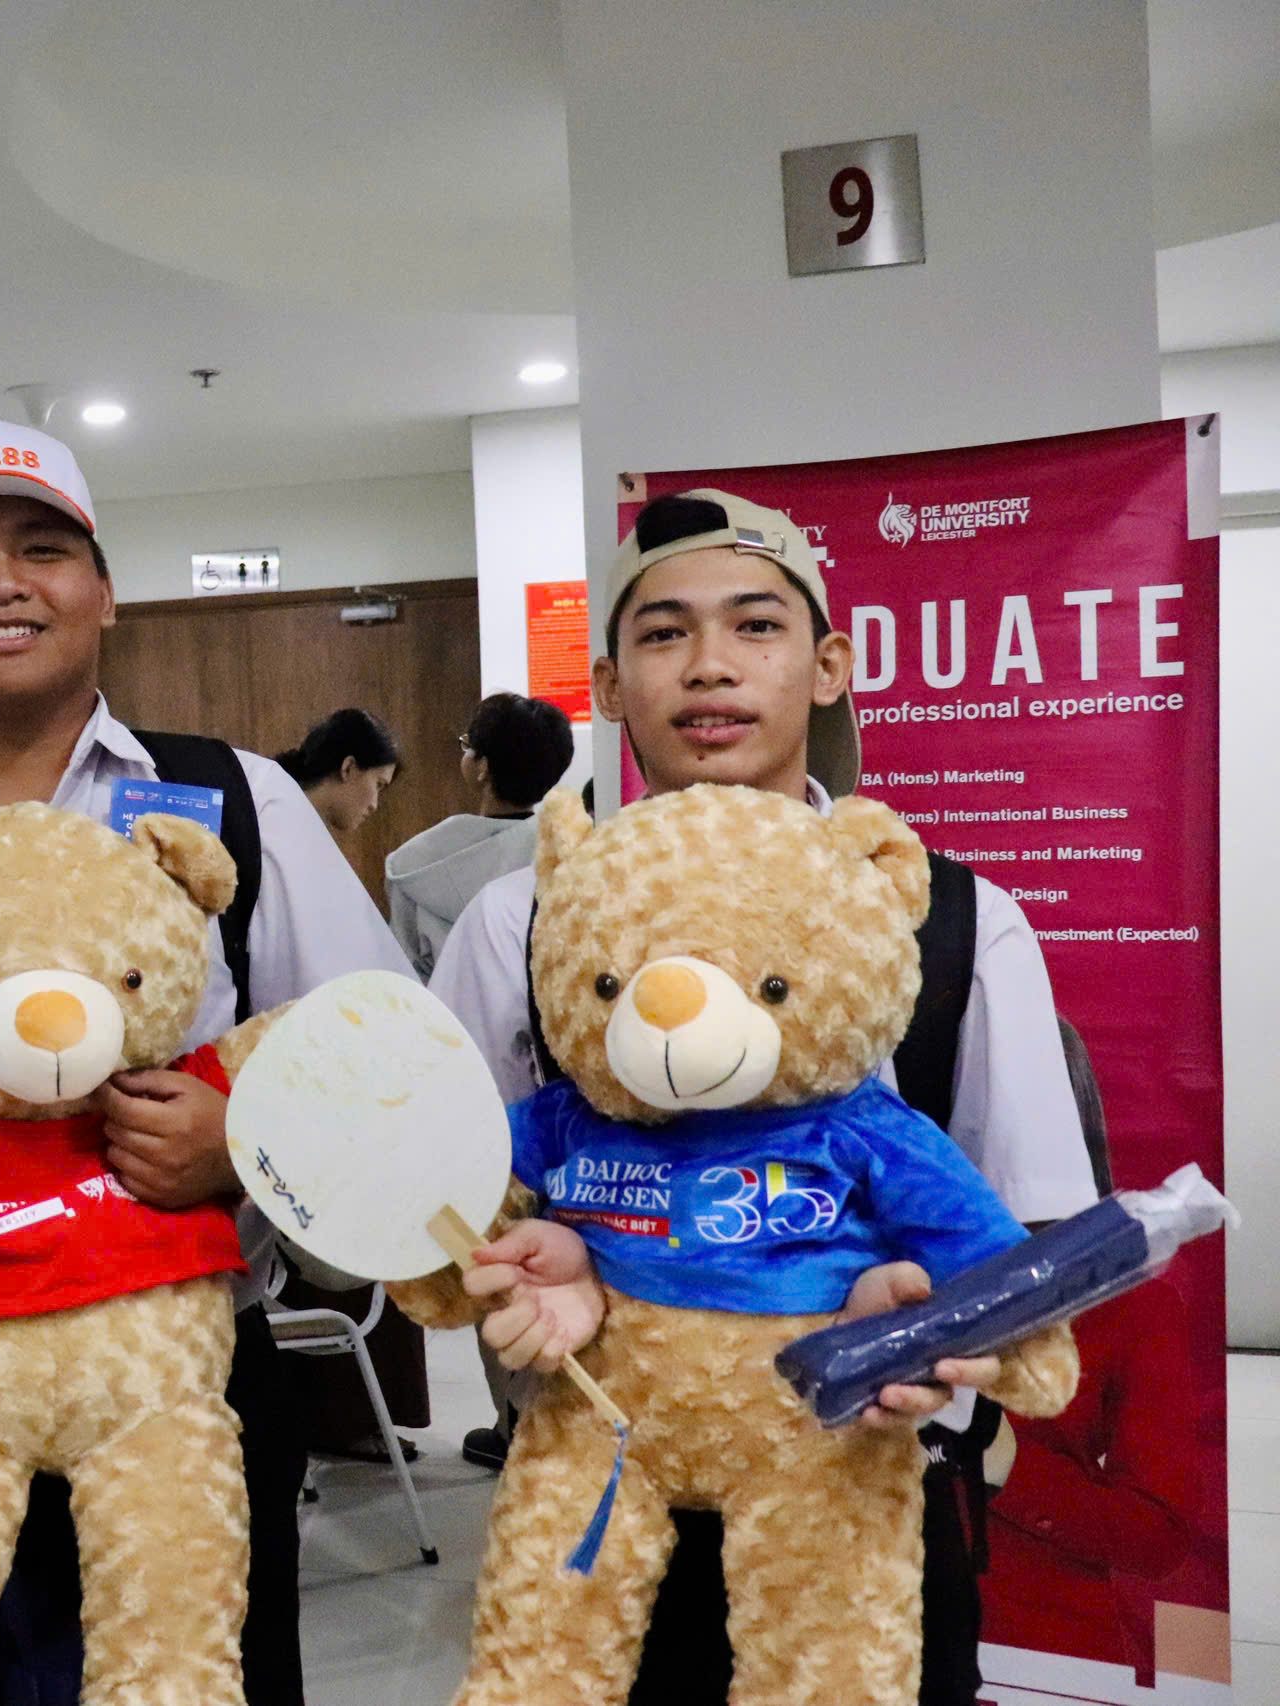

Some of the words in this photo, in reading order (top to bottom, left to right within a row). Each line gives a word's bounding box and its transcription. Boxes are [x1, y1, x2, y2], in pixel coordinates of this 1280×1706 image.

[828, 166, 875, 247] 9
[921, 505, 941, 518] DE
[945, 496, 1031, 516] MONTFORT
[921, 510, 1031, 532] UNIVERSITY
[921, 529, 977, 541] LEICESTER
[859, 696, 1020, 728] professional
[1028, 691, 1184, 719] experience
[861, 774, 883, 786] BA
[888, 771, 939, 786] (Hons)
[943, 769, 1025, 784] Marketing
[943, 807, 1047, 823] International
[1052, 806, 1128, 820] Business
[944, 848, 1017, 862] Business
[1021, 848, 1052, 861] and
[1057, 847, 1143, 861] Marketing
[1011, 887, 1068, 903] Design
[1033, 928, 1114, 941] nvestment
[1117, 926, 1199, 943] (Expected)
[570, 1183, 618, 1204] HOA
[621, 1186, 672, 1211] SEN
